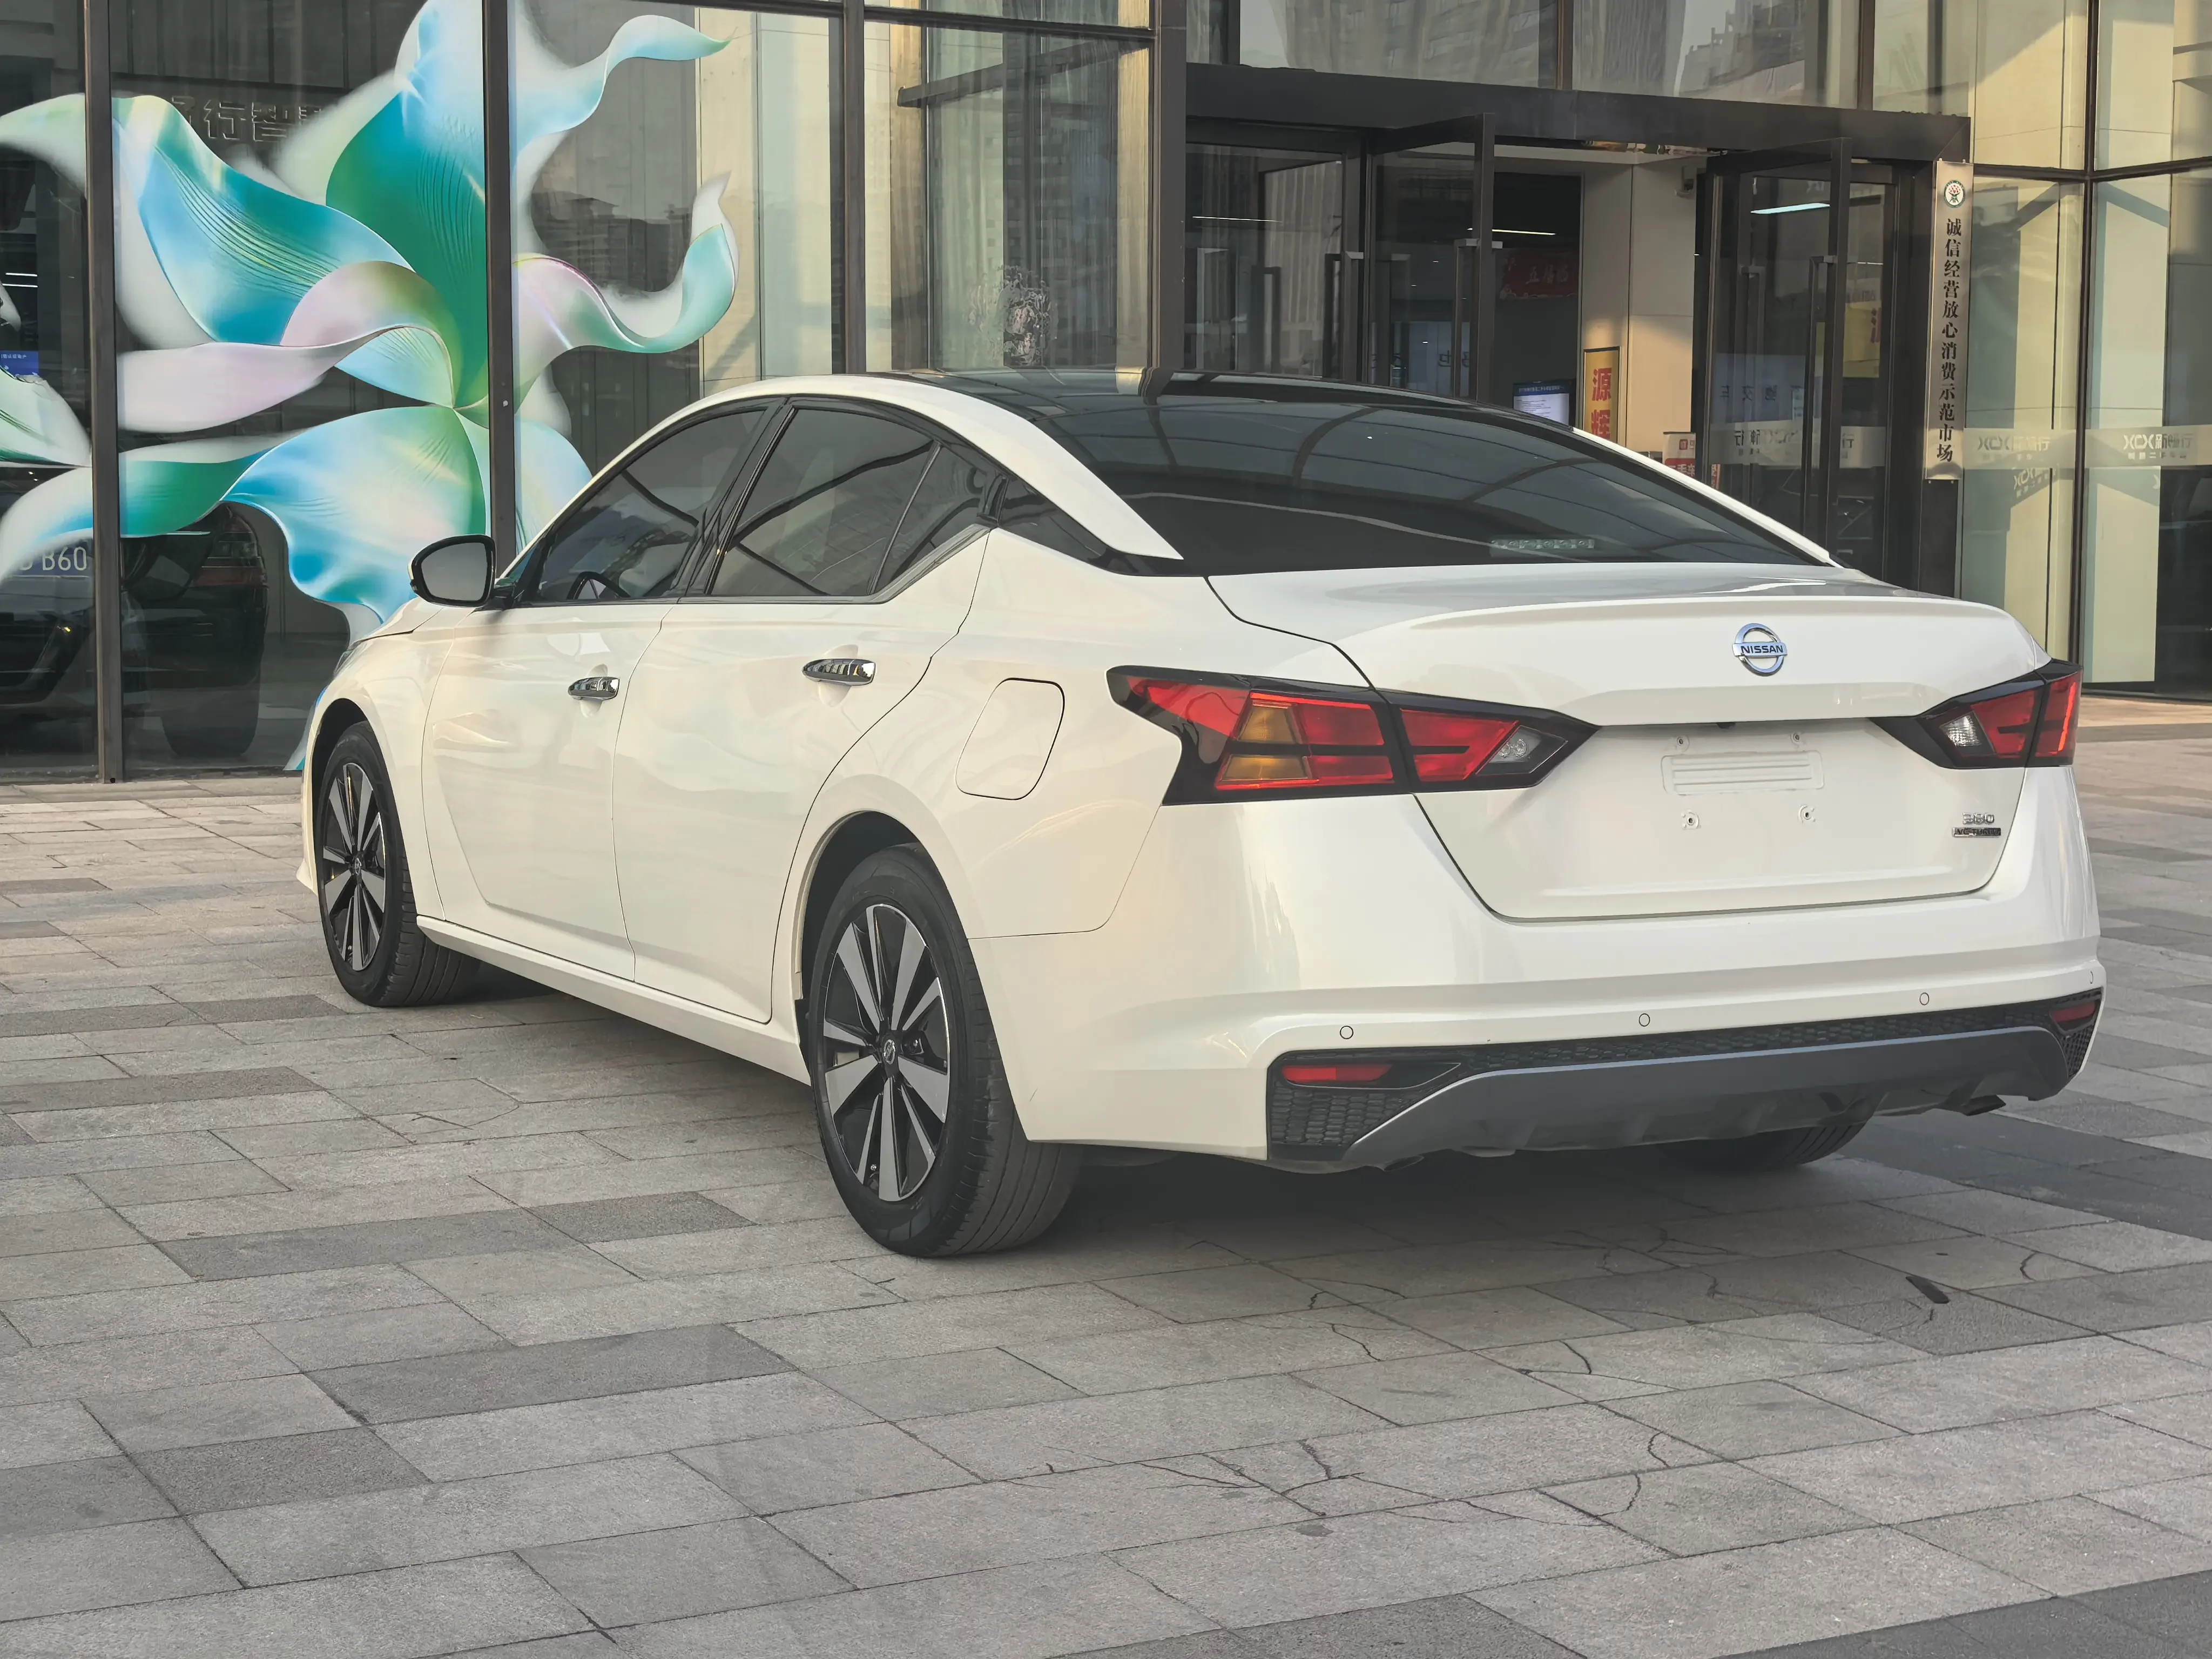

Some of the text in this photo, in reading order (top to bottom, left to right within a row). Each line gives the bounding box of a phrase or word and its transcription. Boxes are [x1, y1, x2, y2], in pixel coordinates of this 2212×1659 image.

[172, 96, 323, 142] 行智
[1937, 218, 1962, 462] 诚信经营放心消费示范市场
[1741, 645, 1783, 653] NISSAN
